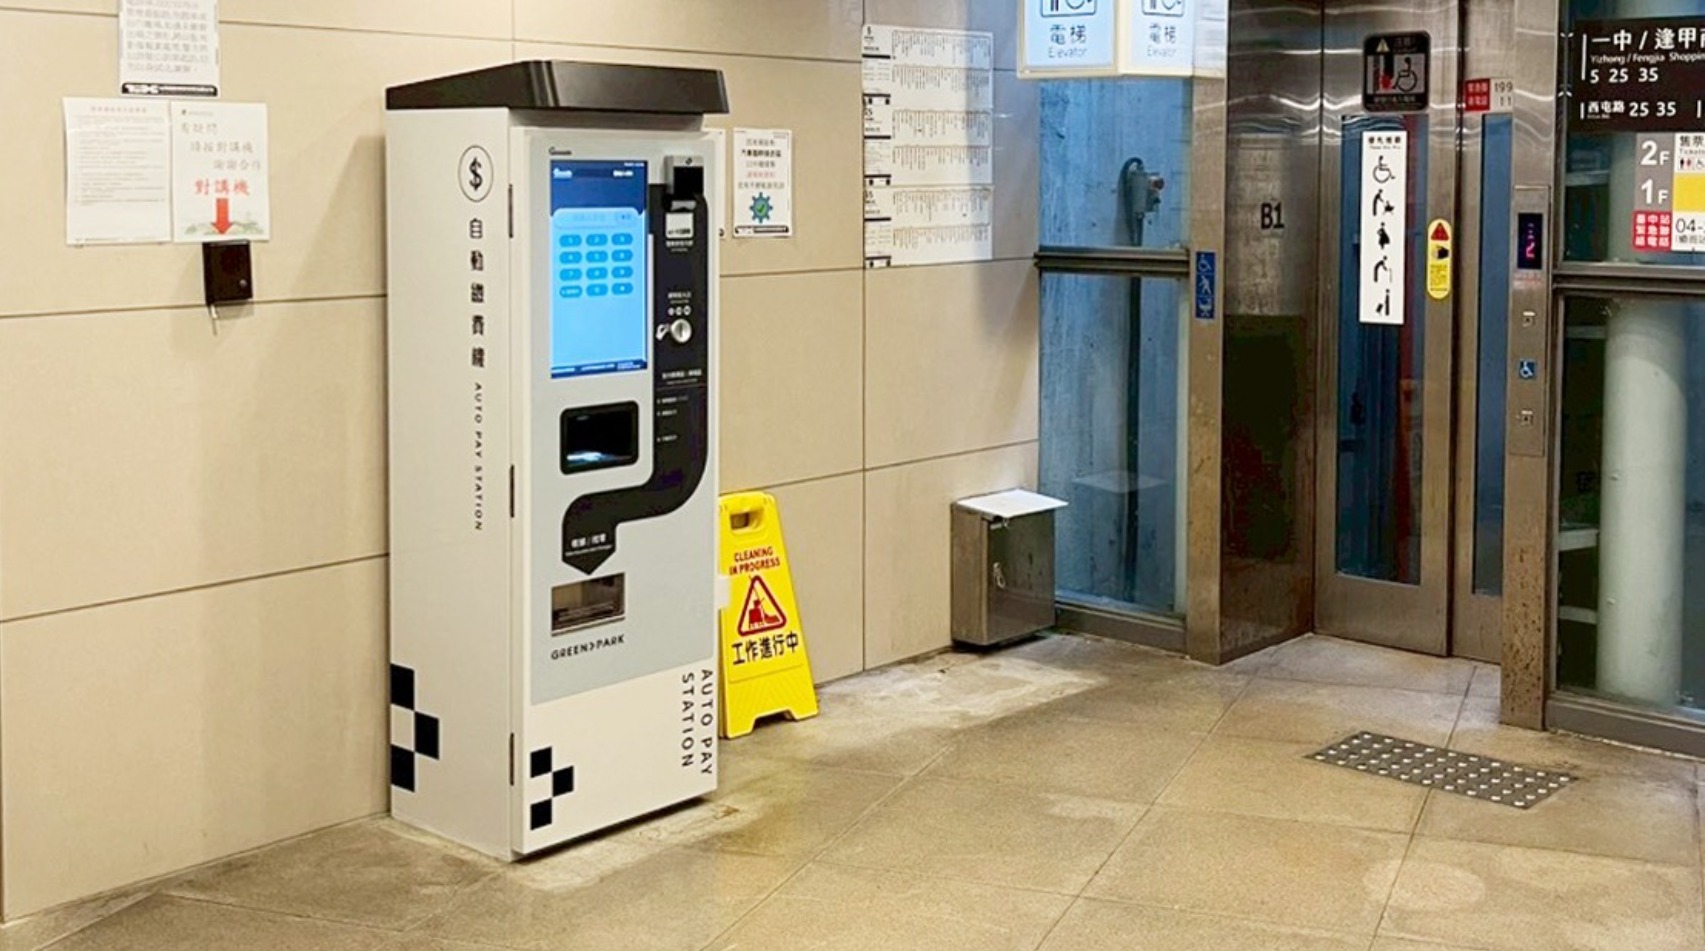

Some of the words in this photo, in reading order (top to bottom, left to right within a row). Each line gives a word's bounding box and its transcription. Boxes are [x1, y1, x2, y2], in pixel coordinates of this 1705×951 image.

[1050, 24, 1086, 45] 電梯
[1149, 23, 1176, 44] 電梯
[1591, 29, 1632, 51] 一中
[1590, 69, 1599, 84] 5
[1608, 68, 1629, 83] 25
[1638, 67, 1658, 82] 35
[1629, 102, 1649, 117] 25
[1656, 101, 1676, 117] 35
[195, 177, 250, 196] 對講機
[1261, 202, 1284, 229] B1
[474, 382, 483, 423] AUTO
[474, 431, 483, 458] PAY
[474, 465, 483, 530] STATION
[735, 546, 773, 562] CLEANING
[740, 556, 780, 573] PROGRESS
[731, 631, 799, 665] 工作進行中
[701, 669, 713, 726] AUTO
[681, 672, 694, 767] STATION
[701, 737, 713, 774] PAY
